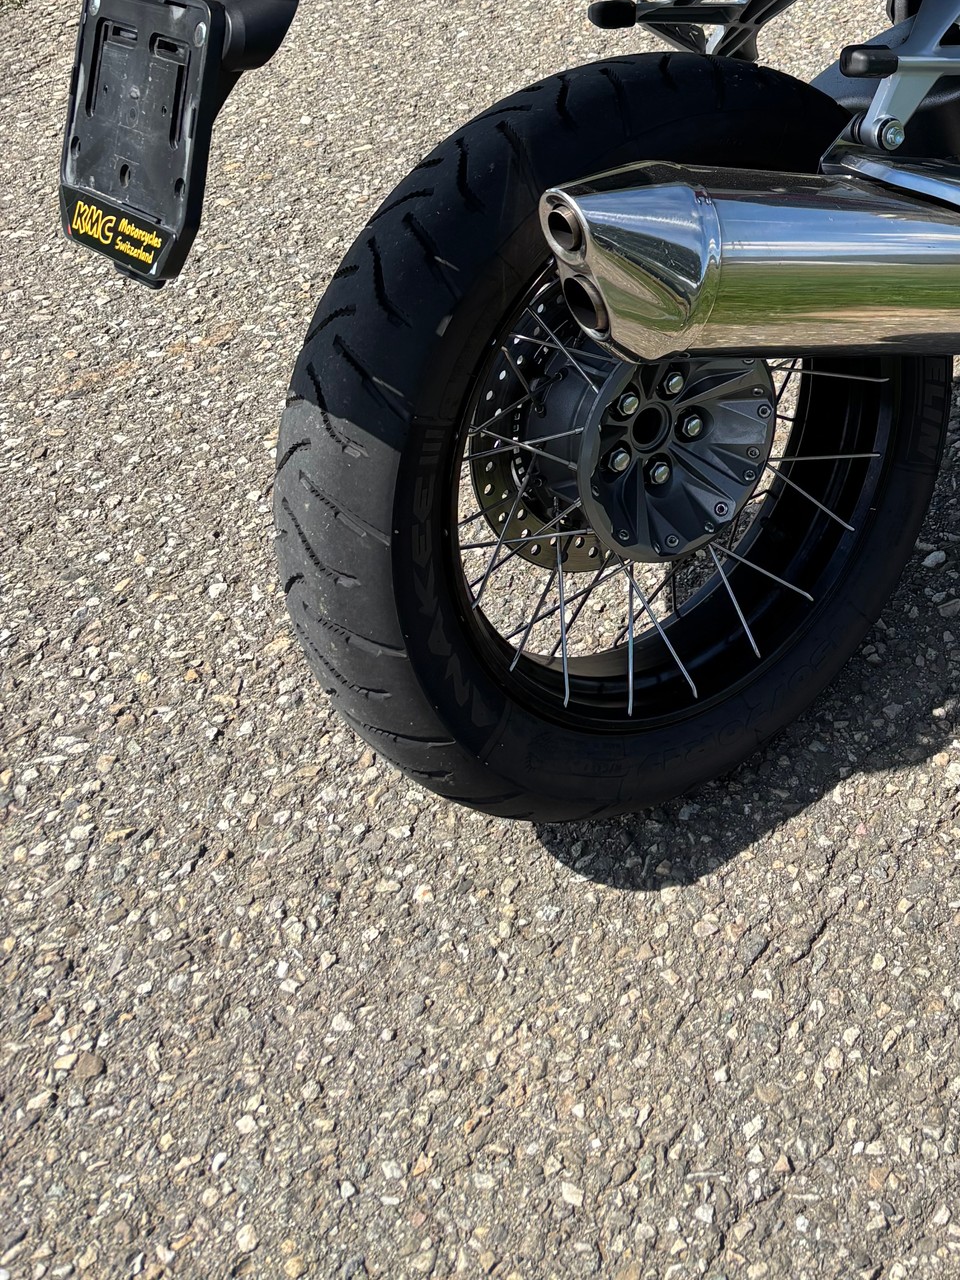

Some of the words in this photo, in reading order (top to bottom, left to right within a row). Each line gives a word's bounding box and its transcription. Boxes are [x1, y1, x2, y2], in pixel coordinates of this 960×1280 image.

[72, 200, 117, 245] KMC
[118, 218, 162, 248] Motorcycles
[115, 236, 154, 264] Switzerland
